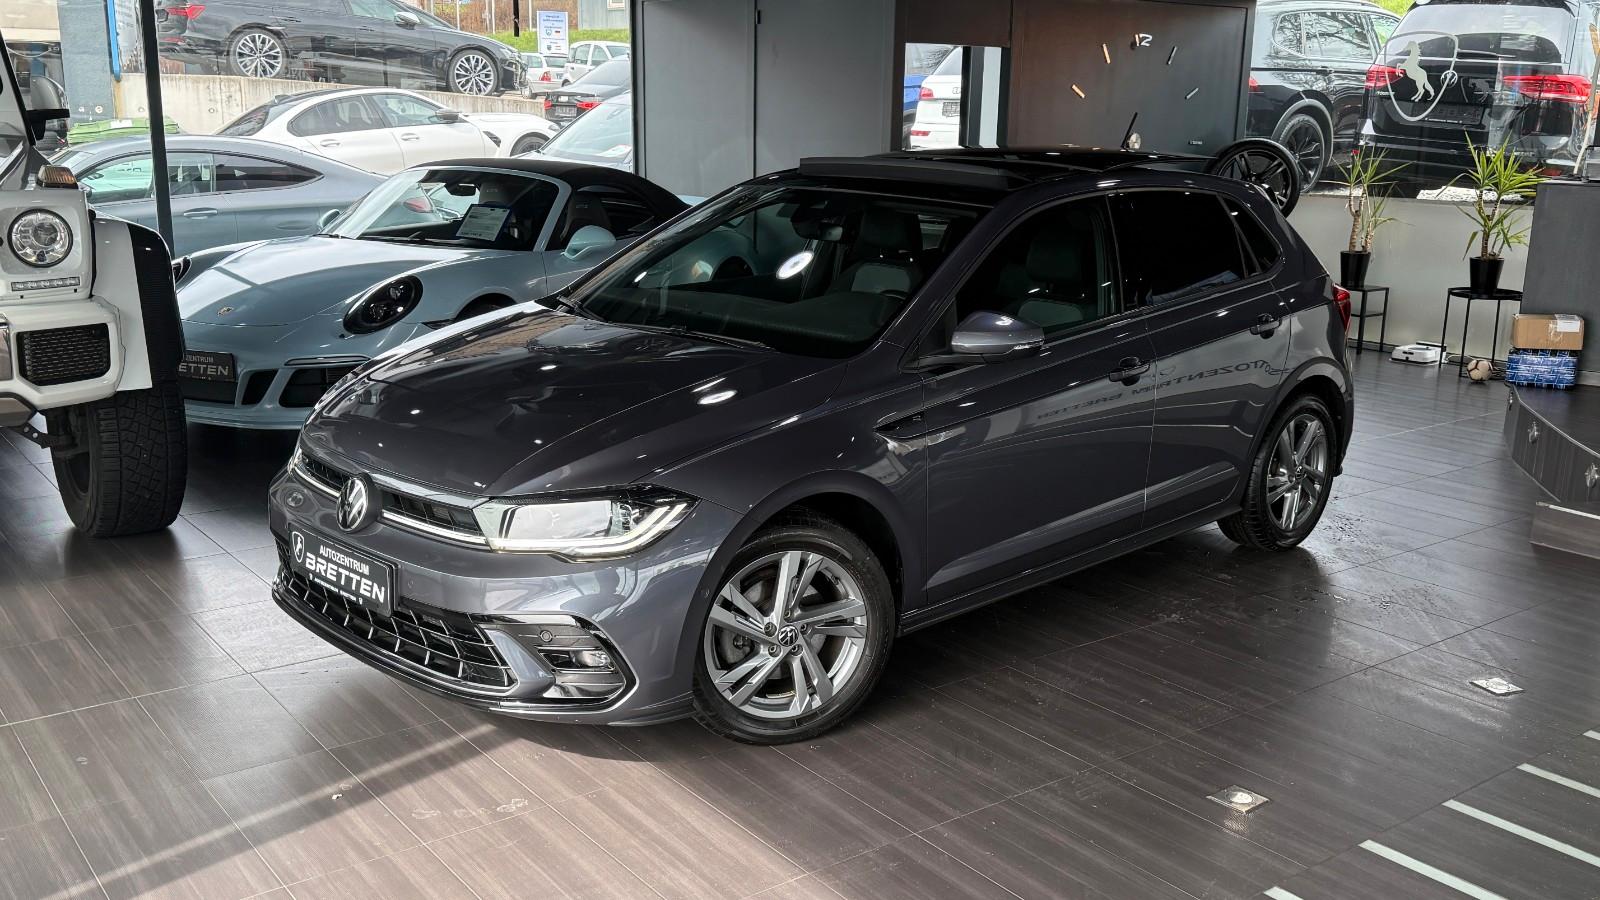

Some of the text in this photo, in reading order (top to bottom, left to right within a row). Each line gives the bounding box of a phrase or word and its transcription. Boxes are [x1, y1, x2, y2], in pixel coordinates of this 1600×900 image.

[1135, 33, 1153, 47] 12
[178, 362, 229, 376] ETTEN
[319, 545, 370, 576] AUTOZENTRUM
[305, 552, 385, 604] BRETTEN
